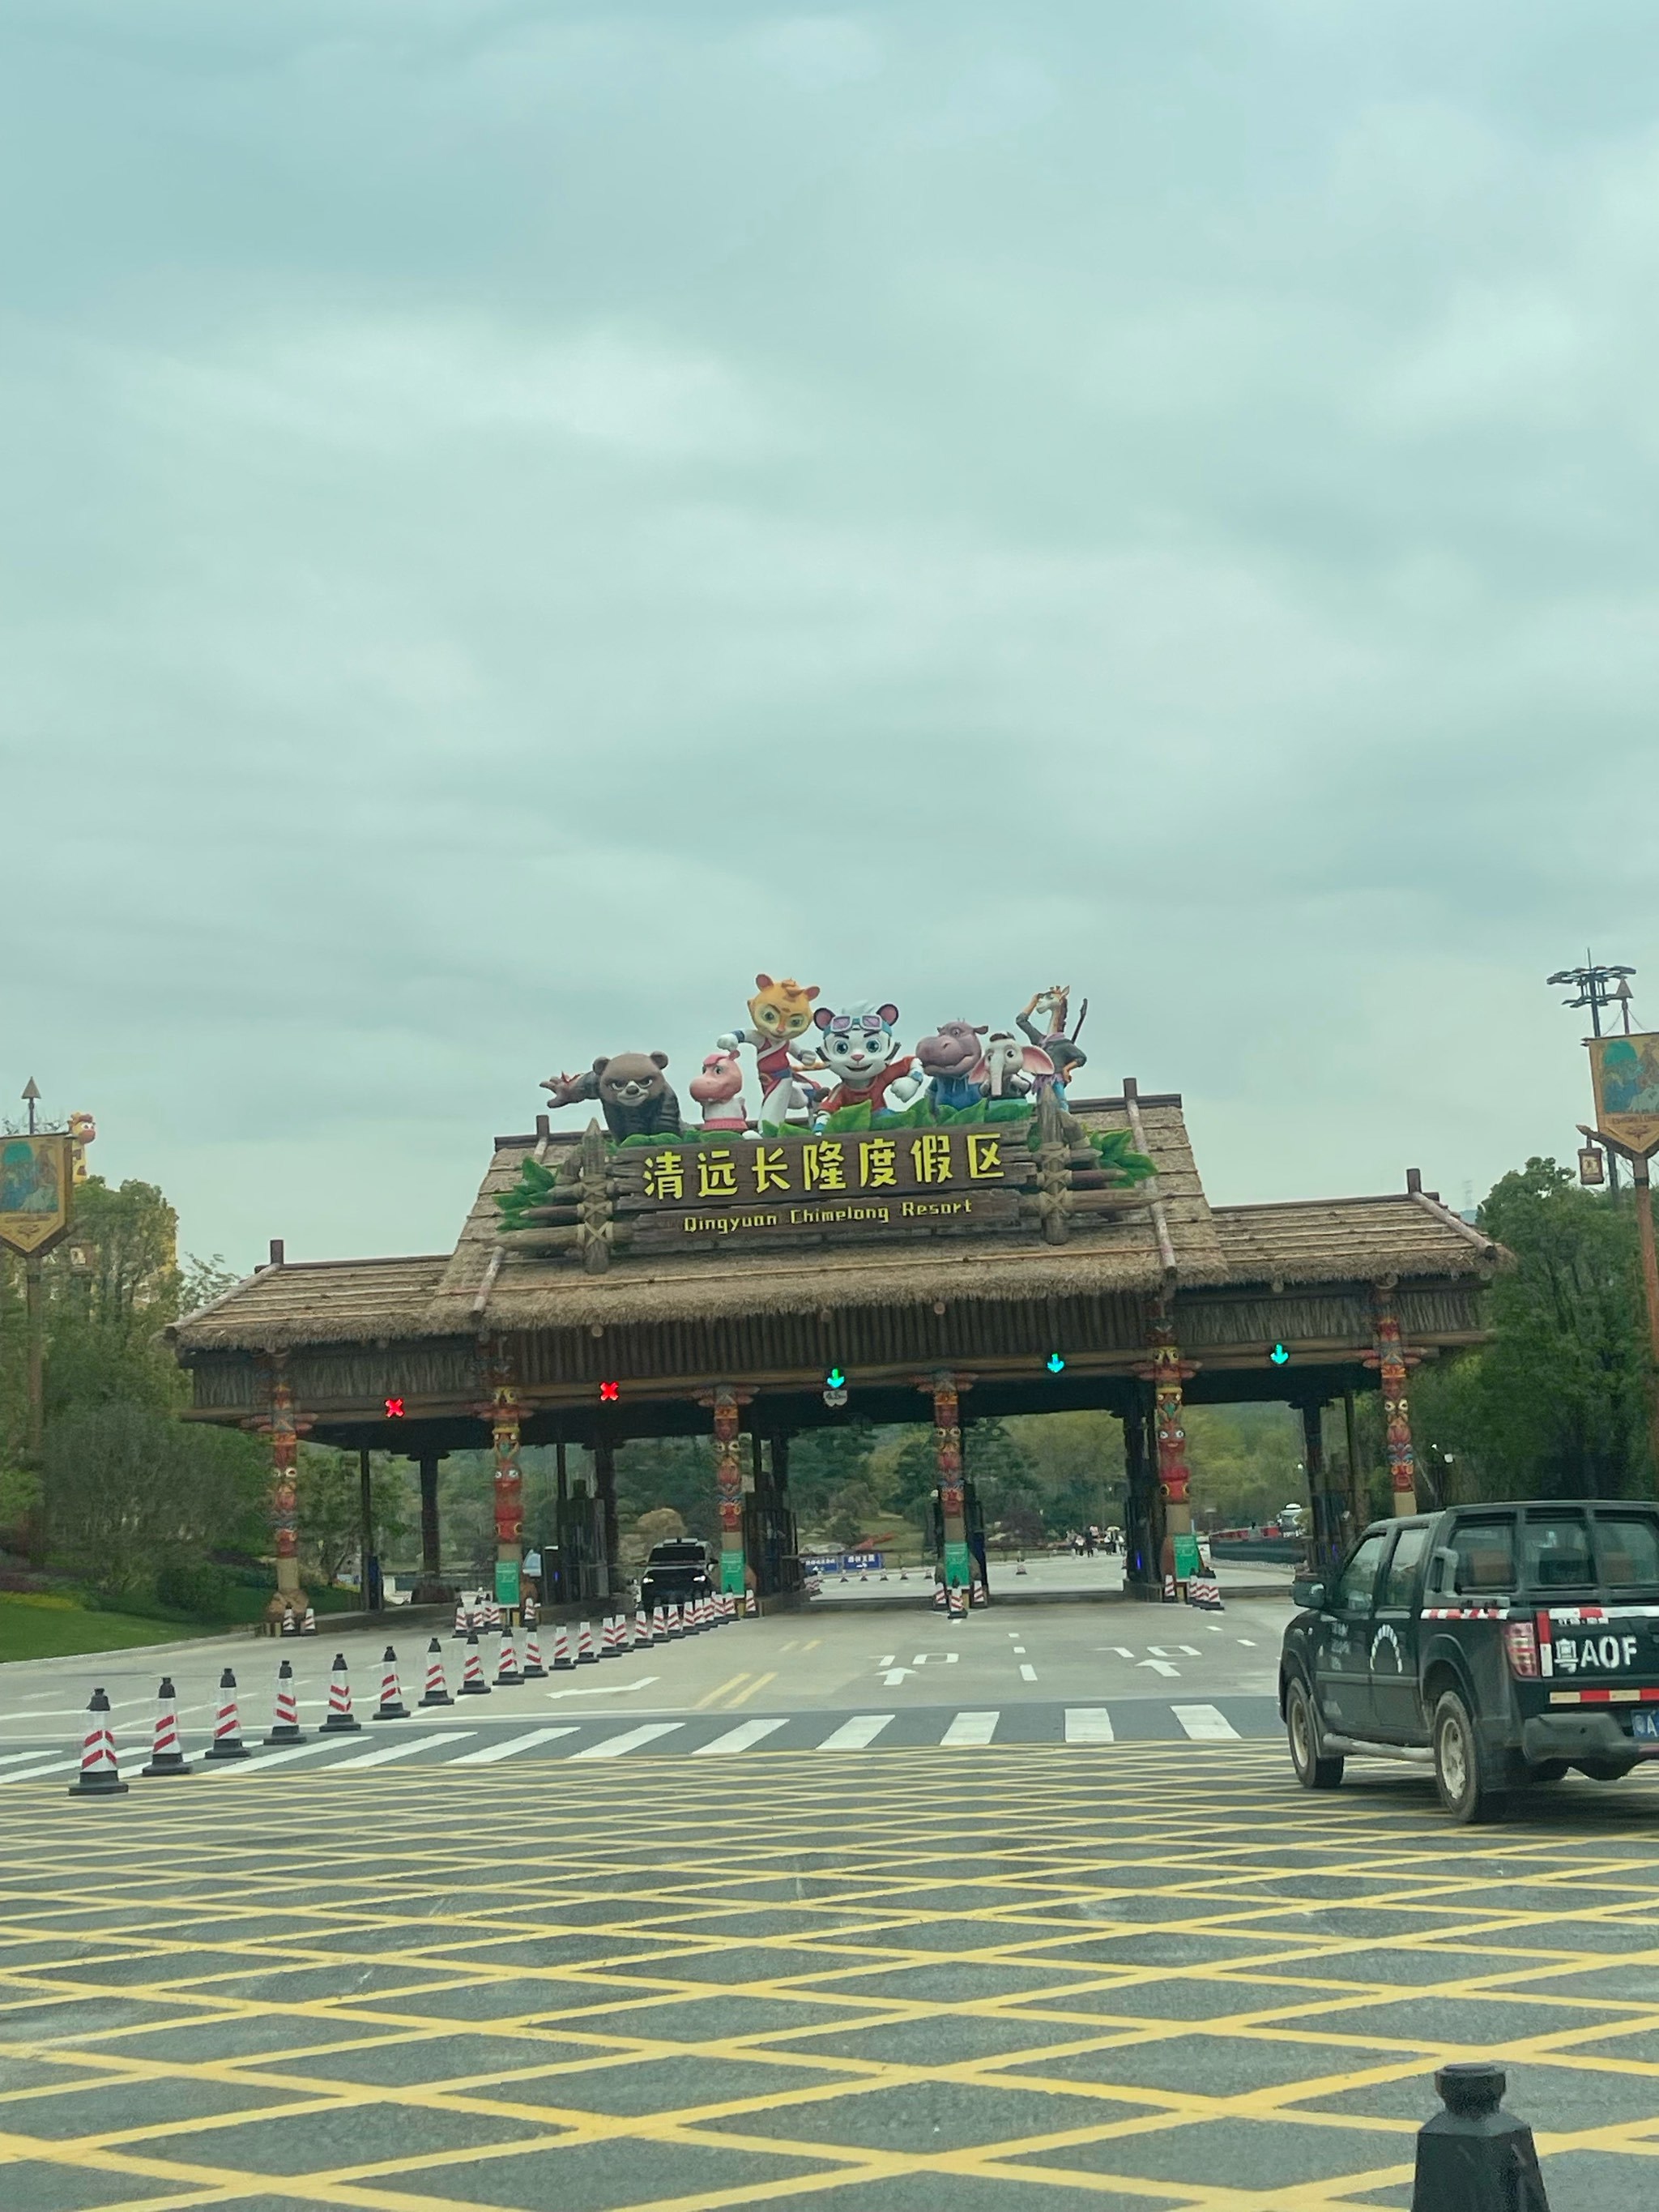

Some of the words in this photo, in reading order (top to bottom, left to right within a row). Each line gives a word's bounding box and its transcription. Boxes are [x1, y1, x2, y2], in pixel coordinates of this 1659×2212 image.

[642, 1133, 1004, 1200] 清远长隆度假区
[684, 1215, 778, 1235] Qingyuan
[790, 1206, 889, 1225] Chimelong
[902, 1198, 972, 1217] Resort
